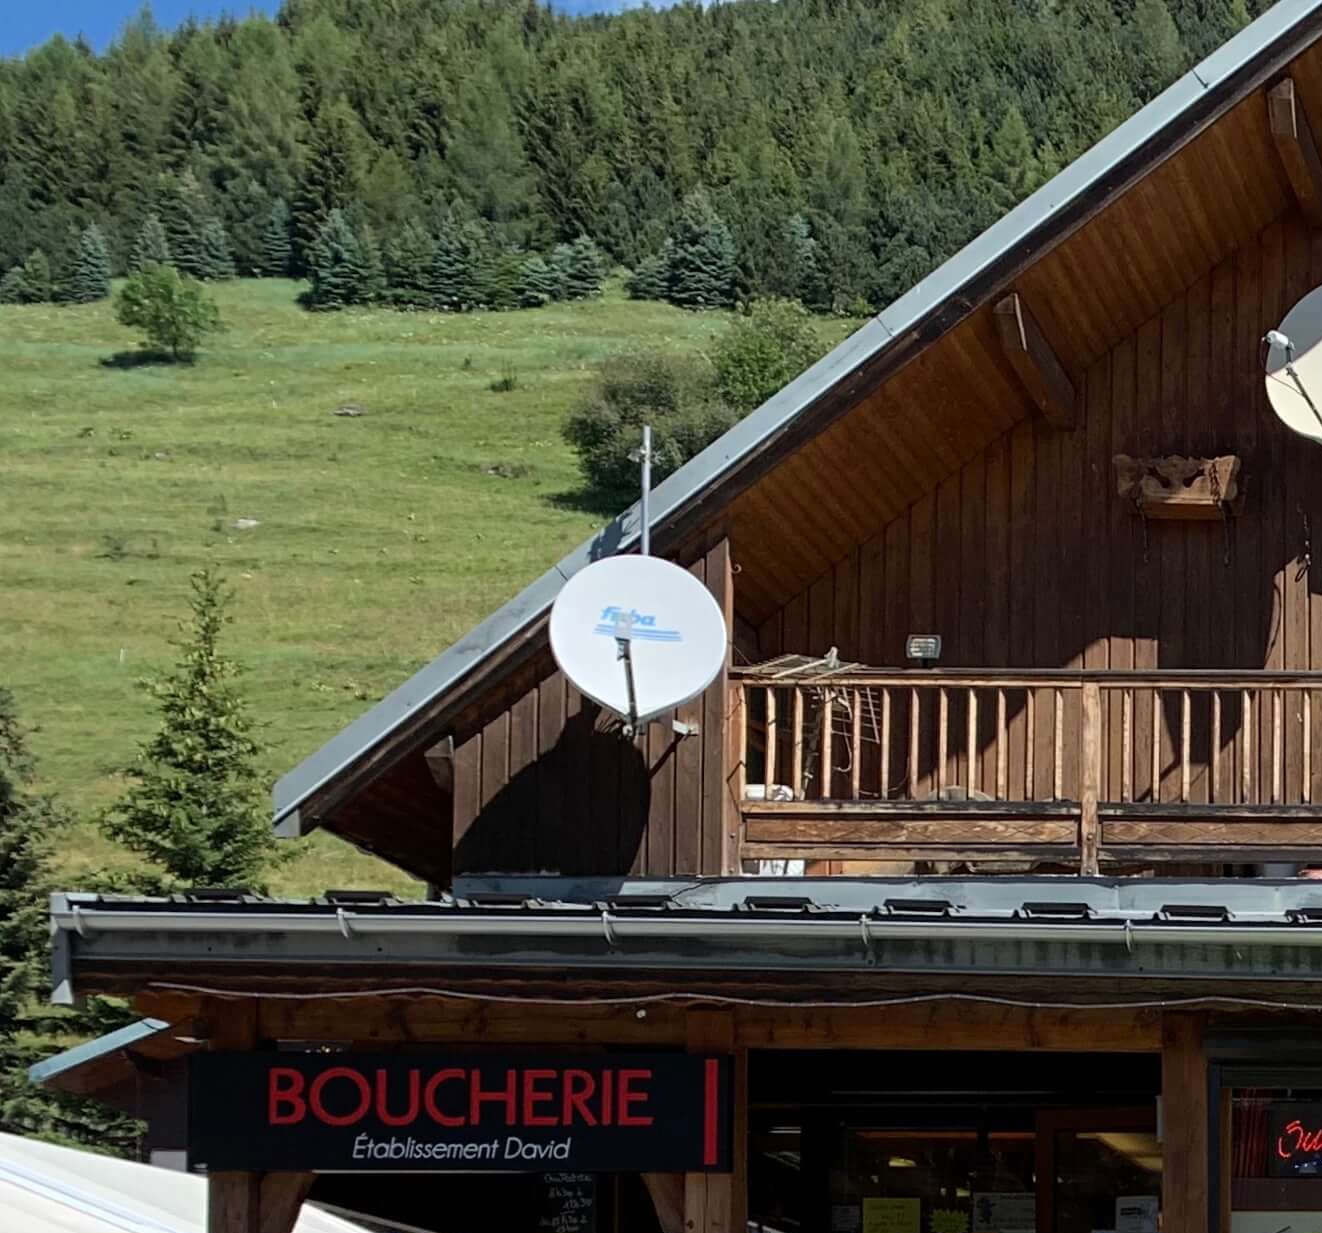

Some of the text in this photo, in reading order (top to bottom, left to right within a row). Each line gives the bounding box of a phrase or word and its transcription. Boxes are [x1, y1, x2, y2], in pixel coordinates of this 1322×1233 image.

[268, 1066, 655, 1127] BOUCHERIE
[352, 1132, 572, 1160] Établissement David
